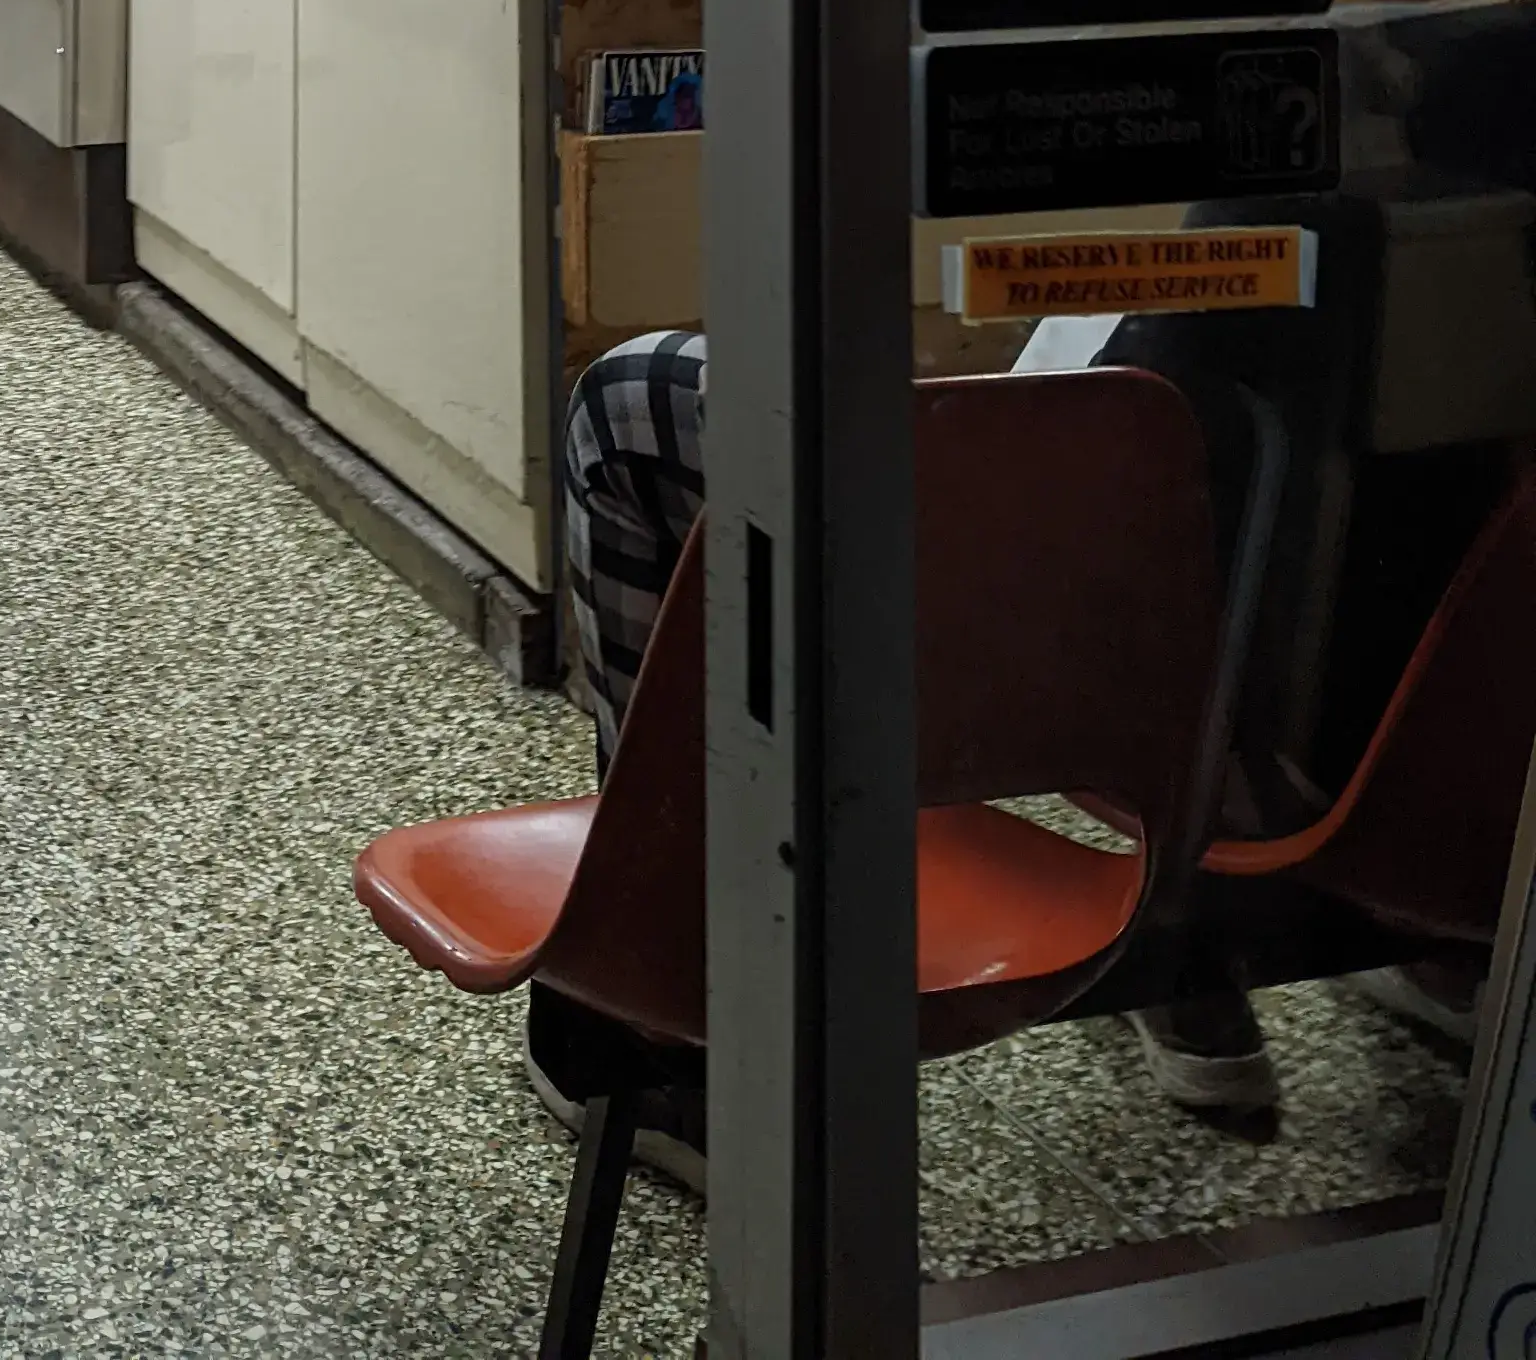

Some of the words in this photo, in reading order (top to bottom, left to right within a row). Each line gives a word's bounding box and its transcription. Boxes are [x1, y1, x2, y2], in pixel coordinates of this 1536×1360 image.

[1005, 80, 1177, 118] Responsible
[1005, 126, 1063, 156] Lost
[1072, 121, 1106, 149] Or
[1114, 115, 1204, 147] Stolen
[973, 247, 1017, 271] WE
[1020, 241, 1143, 270] RESERVE
[1150, 239, 1204, 264] THE
[1207, 235, 1290, 263] RIGHT
[1005, 281, 1038, 306] TO
[1044, 276, 1143, 305] REFUSE
[1149, 272, 1261, 301] SERVICE
